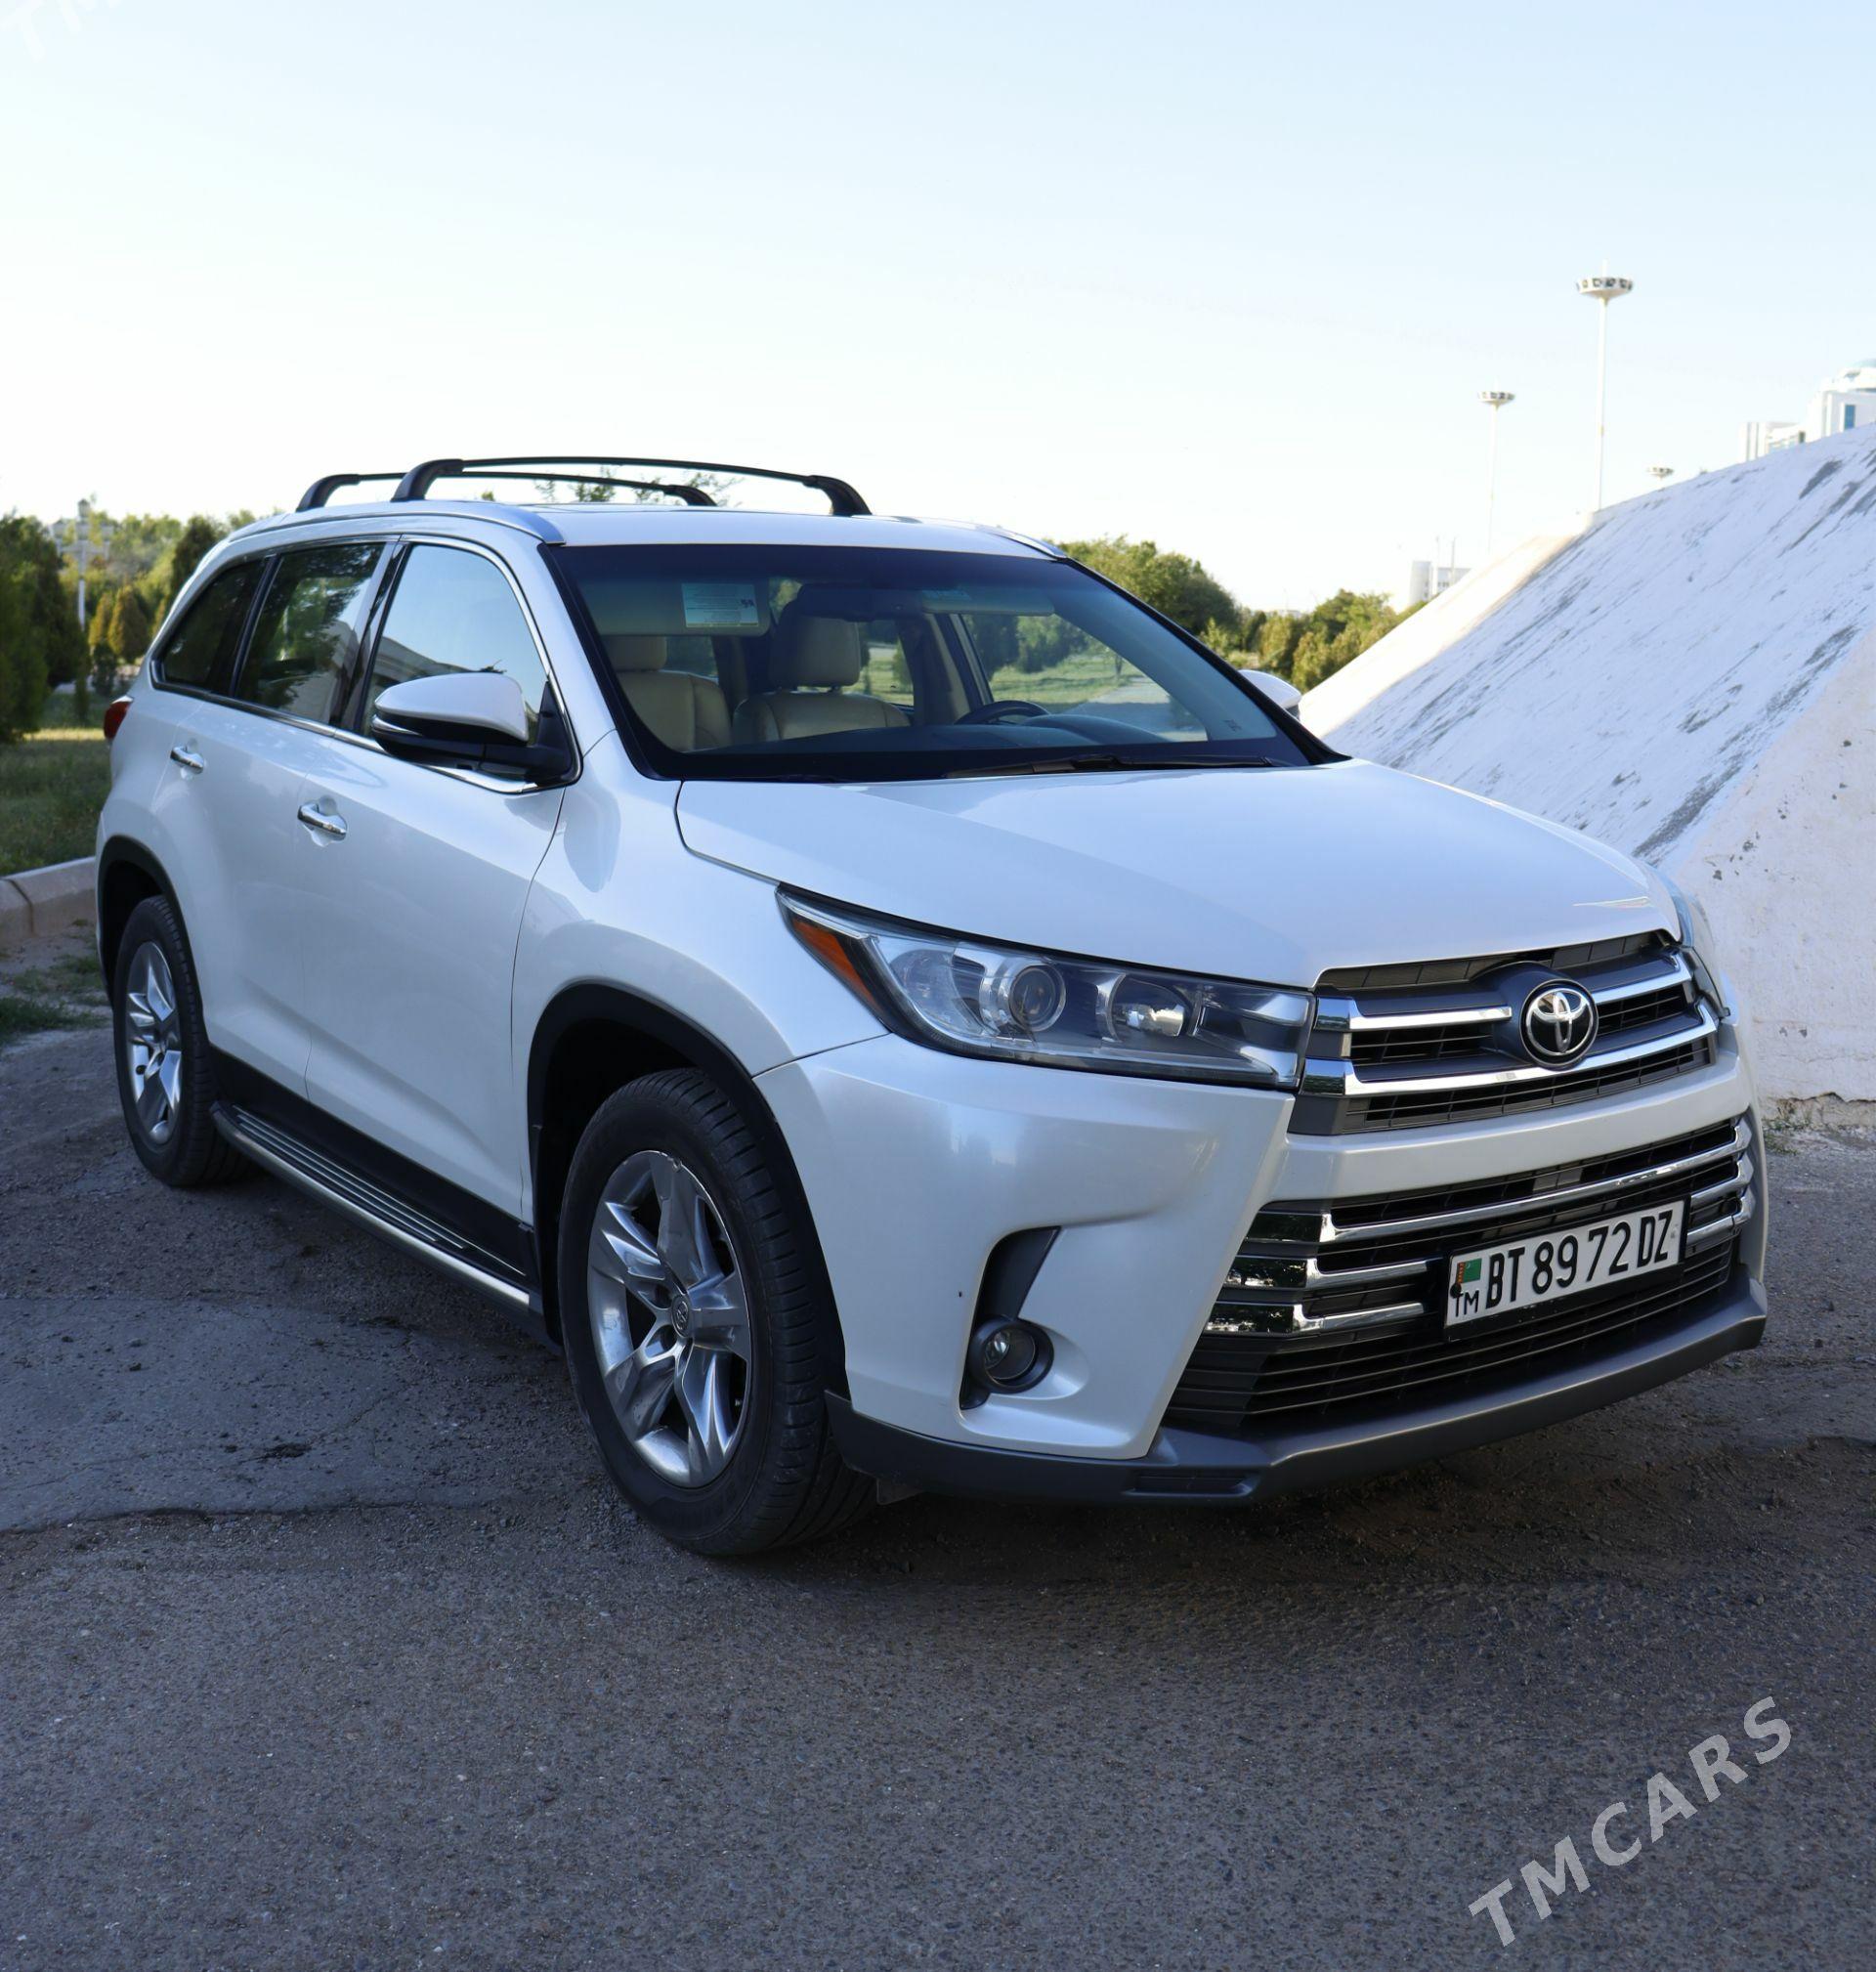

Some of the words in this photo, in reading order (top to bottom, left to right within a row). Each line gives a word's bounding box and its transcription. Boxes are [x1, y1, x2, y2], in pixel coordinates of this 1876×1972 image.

[1485, 1246, 1525, 1309] BT
[1531, 1221, 1632, 1296] 8972
[1636, 1209, 1674, 1268] DZ
